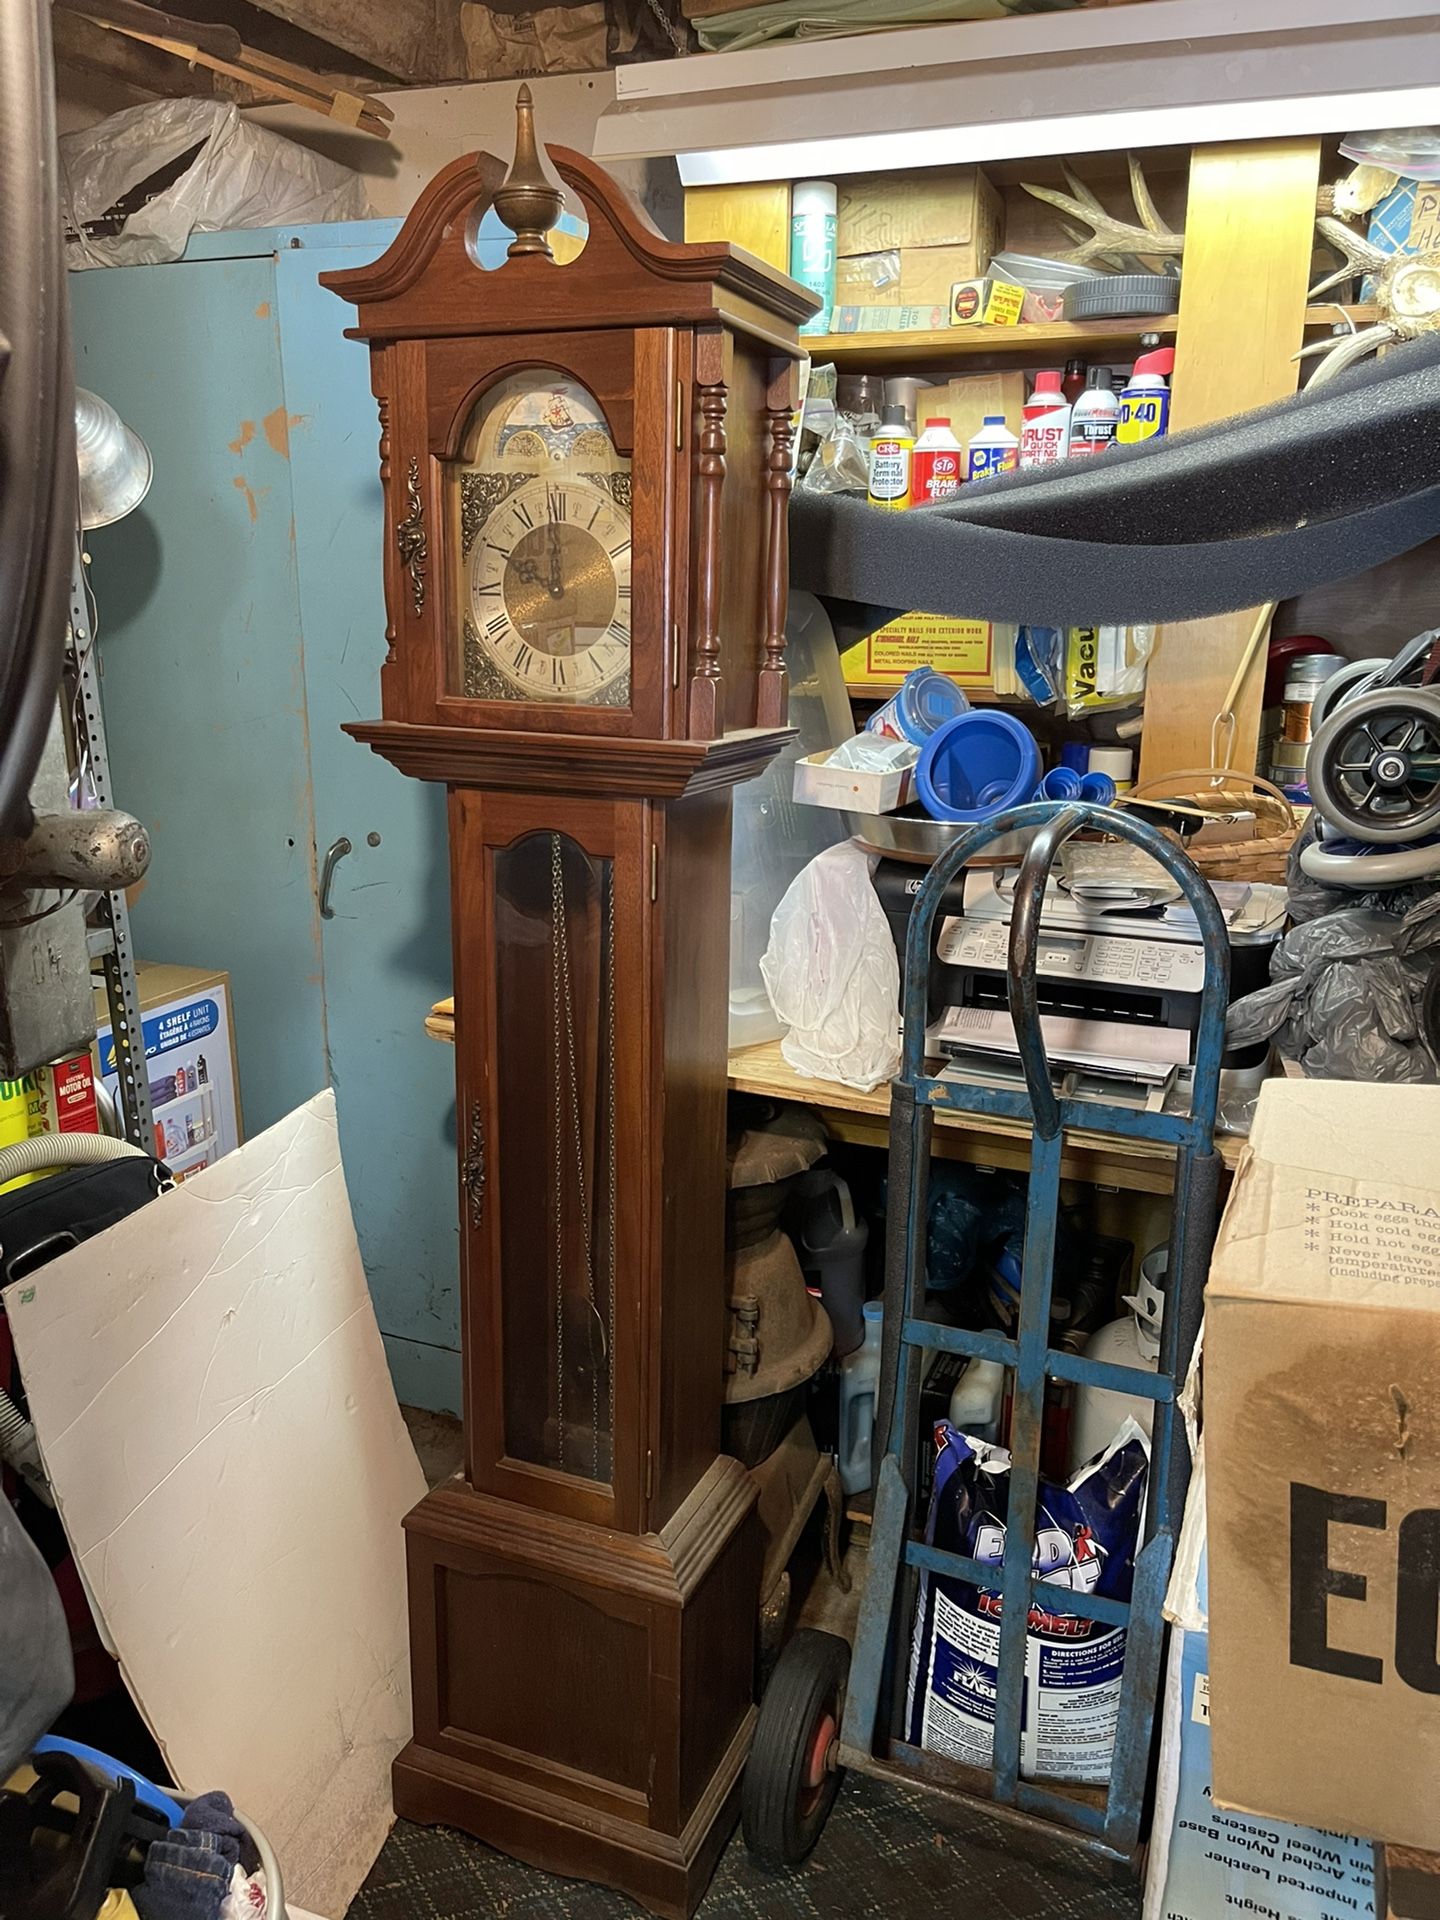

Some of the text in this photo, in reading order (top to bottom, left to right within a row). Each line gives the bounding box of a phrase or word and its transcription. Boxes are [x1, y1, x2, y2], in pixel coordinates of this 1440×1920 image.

[1120, 403, 1158, 423] D-40
[1083, 424, 1114, 435] Thrust
[877, 444, 899, 454] CRC
[873, 469, 903, 477] Termnal
[936, 459, 954, 471] STP
[972, 466, 995, 480] Brake
[925, 479, 958, 489] BRAKE
[159, 1004, 209, 1031] 4 SHELF UNIT
[59, 1077, 91, 1096] MOTOR OIL
[1329, 1207, 1369, 1219] Cook
[1374, 1213, 1409, 1225] eggs
[1329, 1220, 1370, 1232] Hold
[1375, 1225, 1411, 1237] cold
[1329, 1233, 1370, 1245] Hold
[1377, 1237, 1406, 1249] hot
[1328, 1246, 1433, 1267] Never leave
[1328, 1267, 1401, 1284] (including
[973, 1525, 1074, 1570] ED
[1028, 1609, 1095, 1637] MELT
[1051, 1647, 1097, 1657] DIRECTIONS
[1099, 1640, 1112, 1651] FOR
[1178, 1819, 1219, 1840] Base
[1211, 1814, 1280, 1844] Casters
[1227, 1834, 1275, 1859] Nylon
[1287, 1838, 1341, 1866] Wheel
[1204, 1851, 1270, 1880] Leather
[1282, 1851, 1345, 1880] Arched
[1277, 1874, 1357, 1909] Imported
[1224, 1893, 1281, 1920] Height
